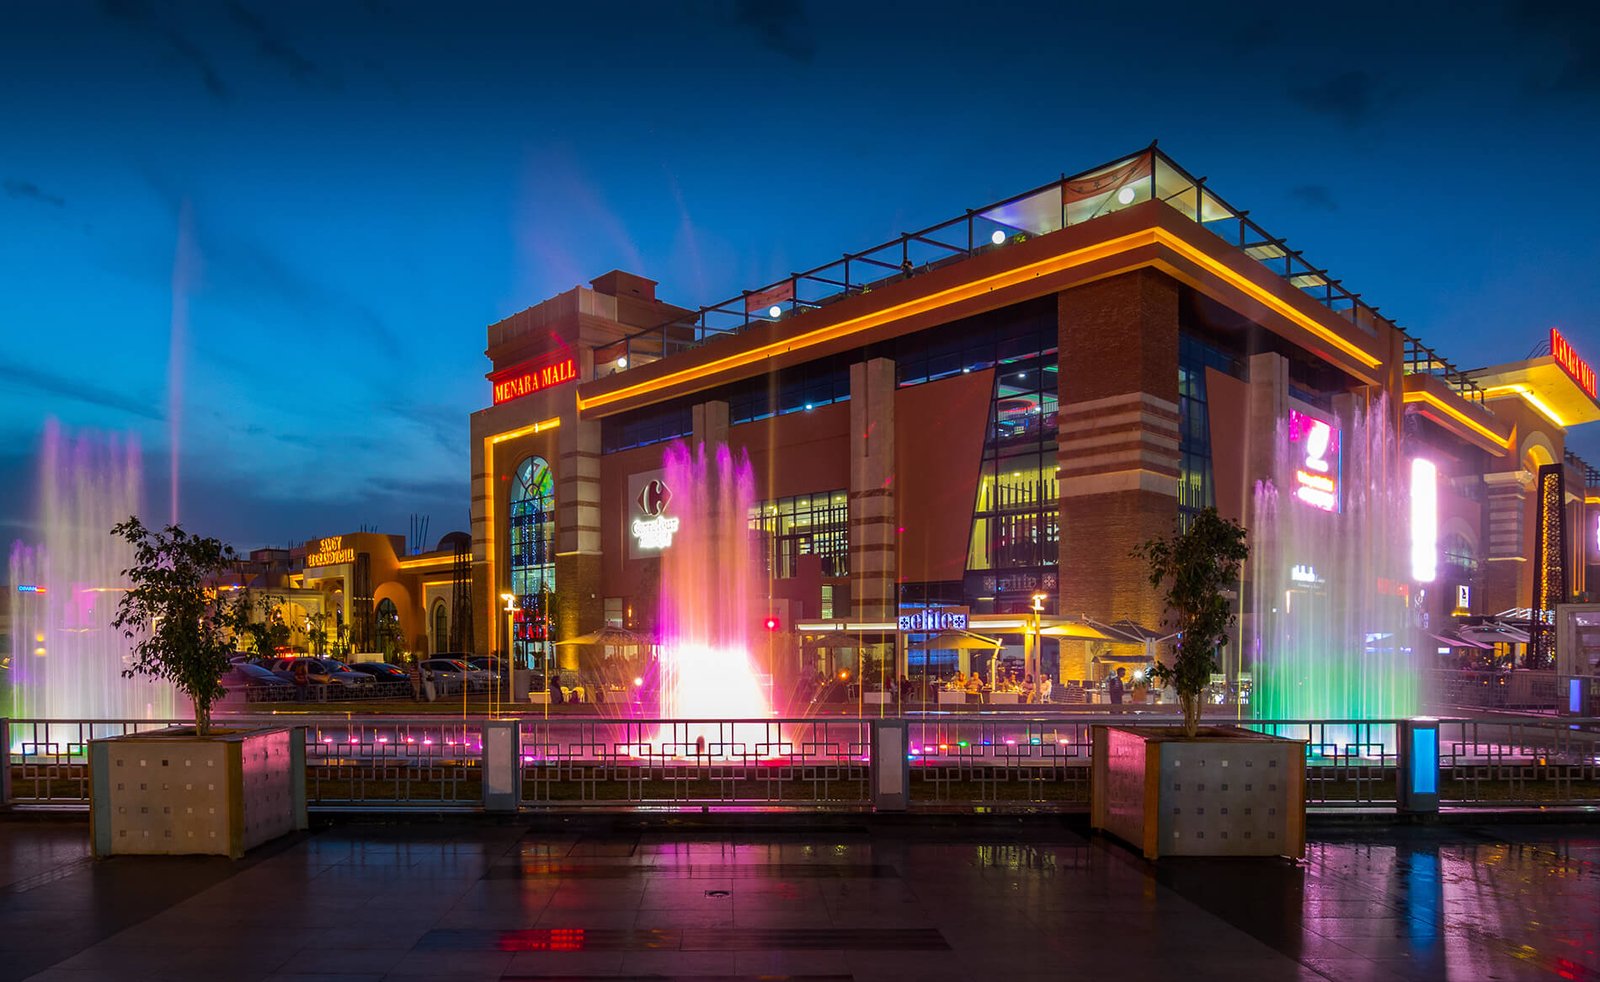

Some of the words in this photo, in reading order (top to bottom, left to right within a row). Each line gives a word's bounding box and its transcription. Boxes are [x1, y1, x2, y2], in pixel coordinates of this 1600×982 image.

[494, 373, 539, 403] MENARA
[542, 359, 576, 387] MALL
[910, 609, 954, 630] elite
